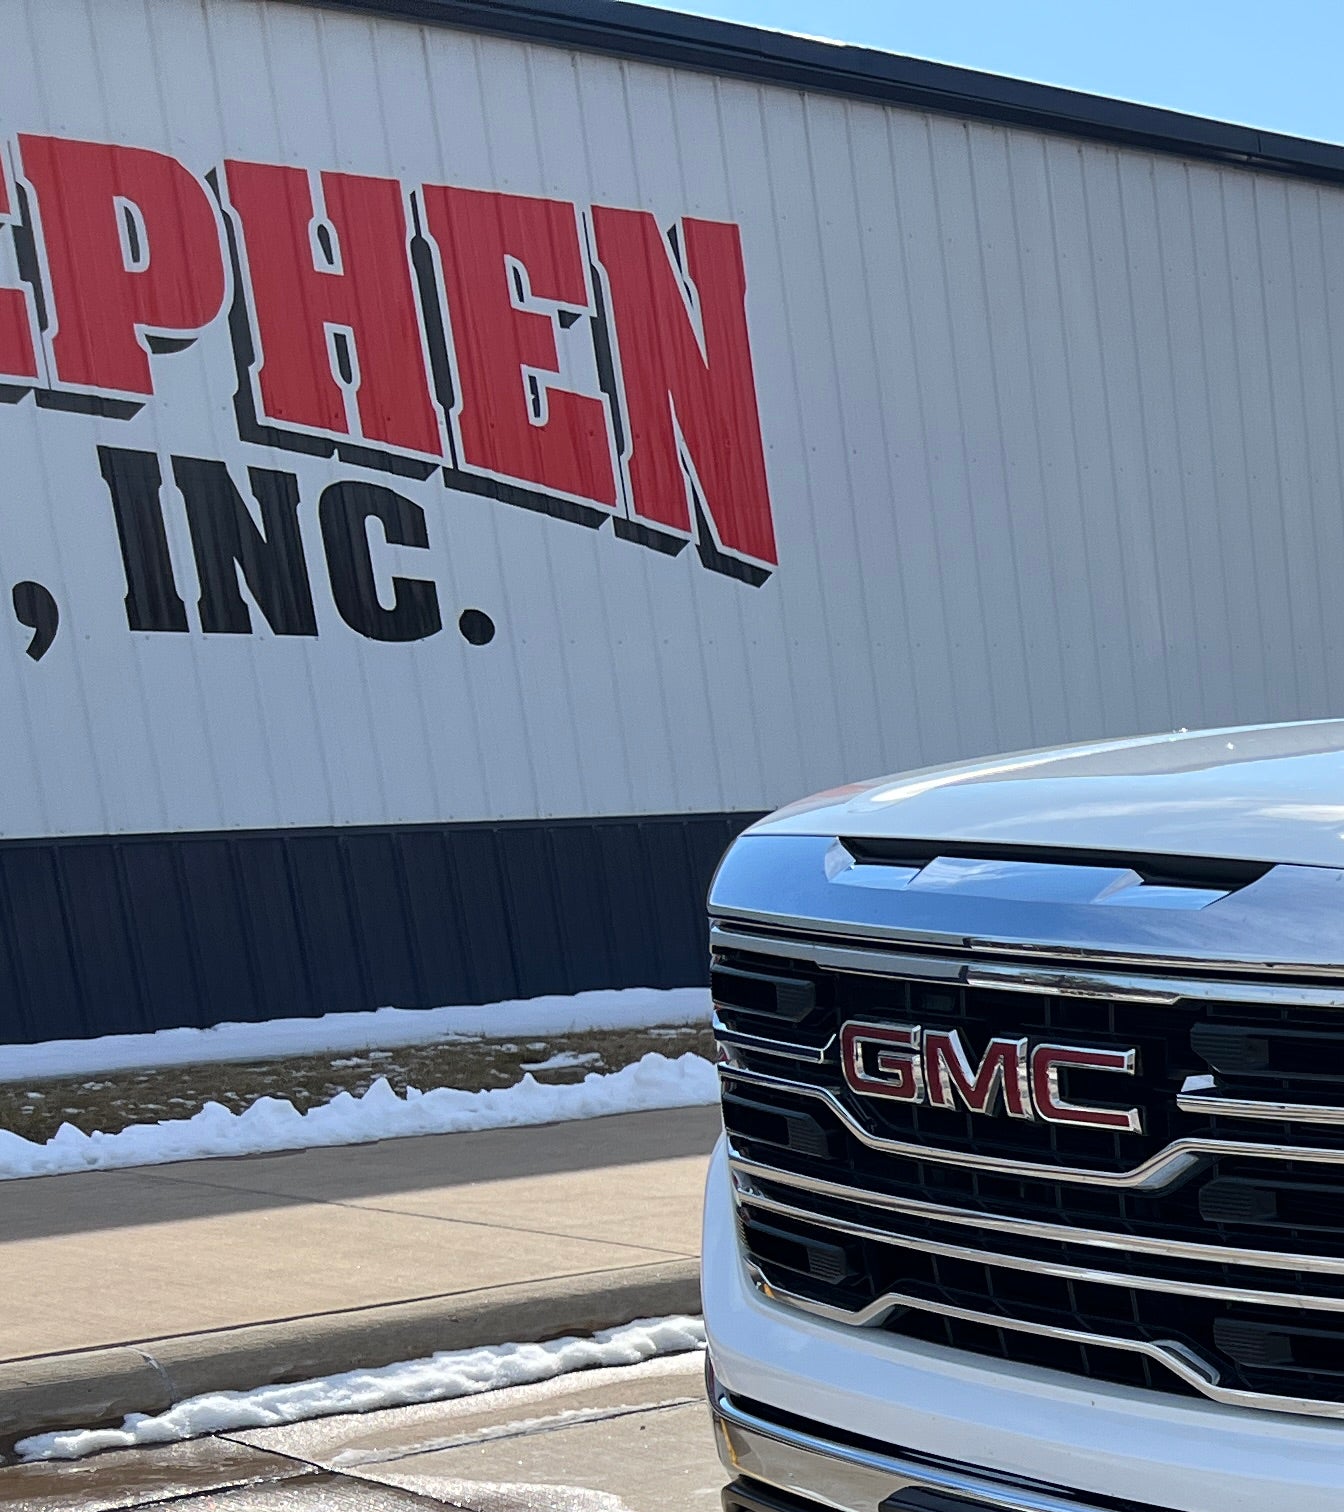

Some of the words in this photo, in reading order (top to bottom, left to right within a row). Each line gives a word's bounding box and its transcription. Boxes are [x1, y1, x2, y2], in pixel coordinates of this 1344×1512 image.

[0, 133, 779, 587] PHEN
[96, 445, 496, 646] INC.
[839, 1019, 1145, 1136] GMC
